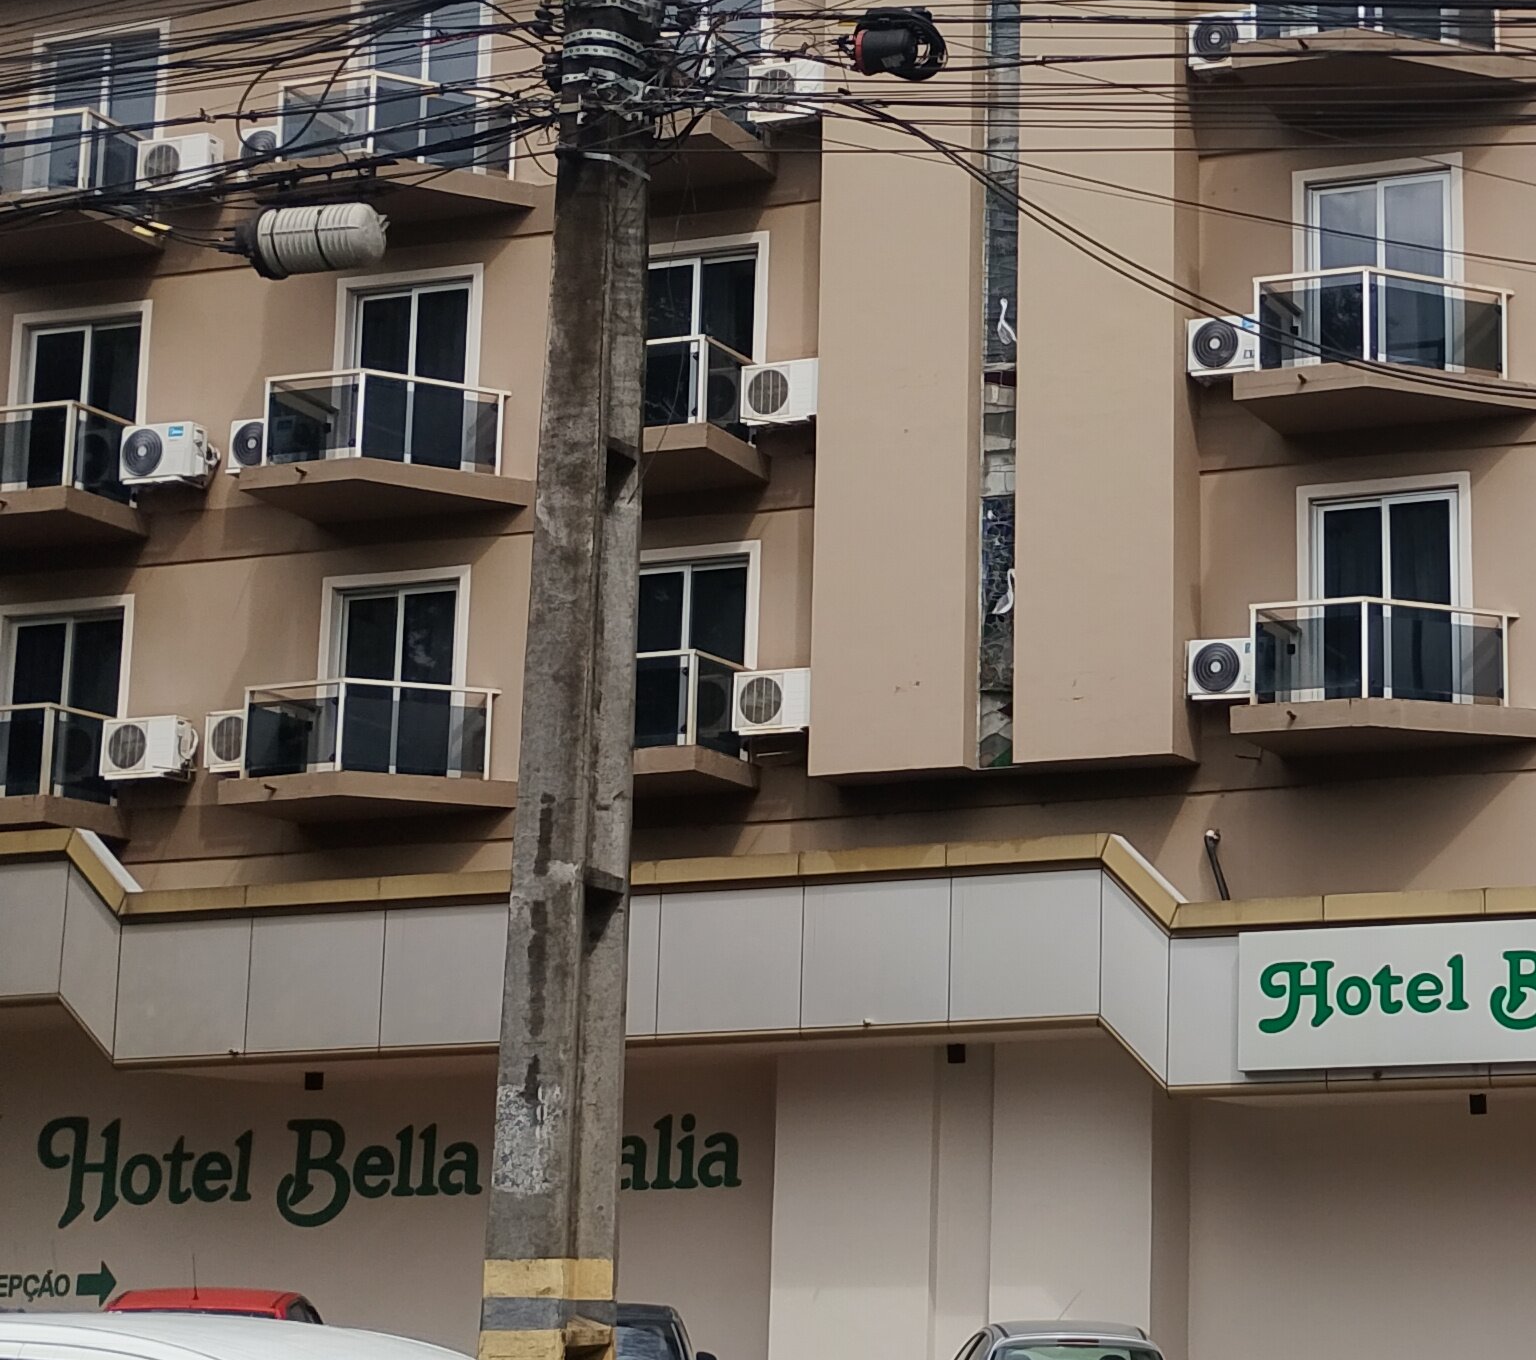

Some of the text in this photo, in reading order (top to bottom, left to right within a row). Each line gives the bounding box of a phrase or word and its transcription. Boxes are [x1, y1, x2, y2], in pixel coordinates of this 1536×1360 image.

[1258, 953, 1469, 1033] Hotel
[37, 1113, 742, 1229] Hotel Bella alia
